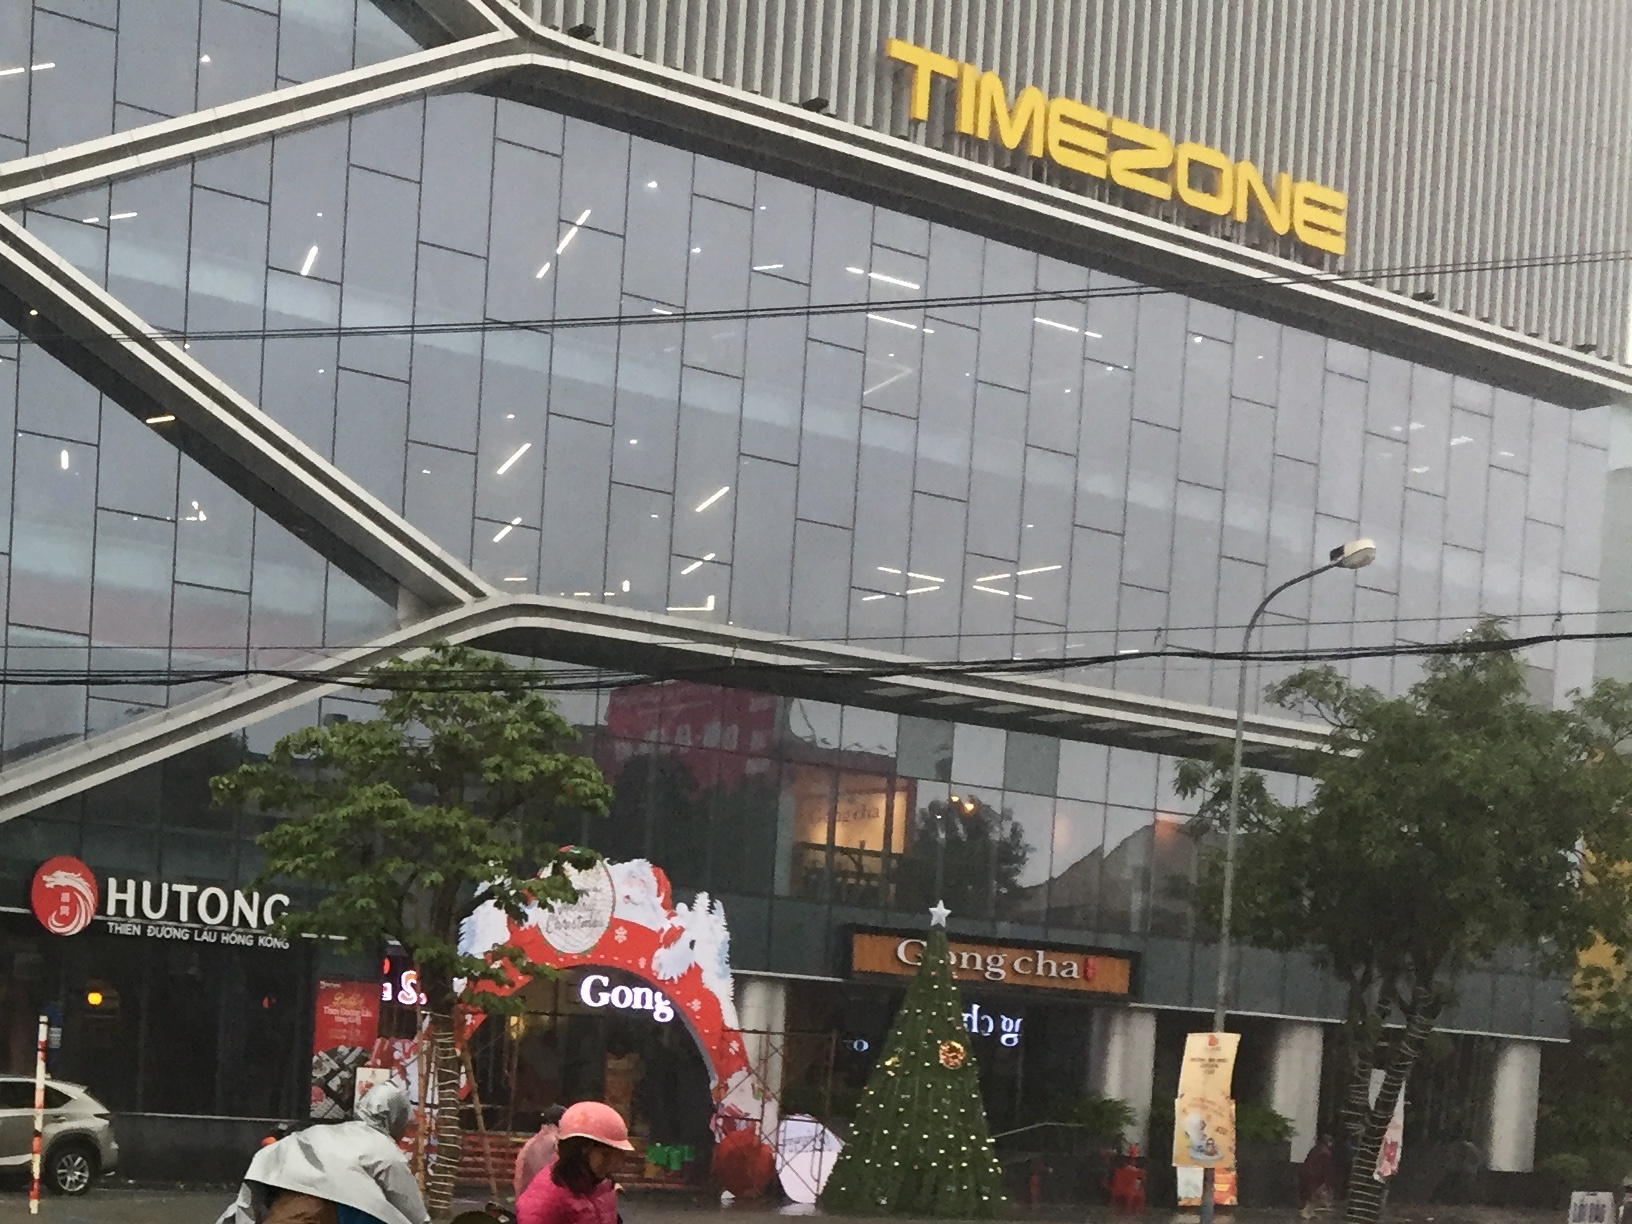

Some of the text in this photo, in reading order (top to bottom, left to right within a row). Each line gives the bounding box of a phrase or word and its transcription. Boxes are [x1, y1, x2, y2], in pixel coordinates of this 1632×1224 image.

[885, 37, 1348, 255] TIMEZONE
[1013, 950, 1081, 979] cha
[580, 974, 675, 1023] Gong
